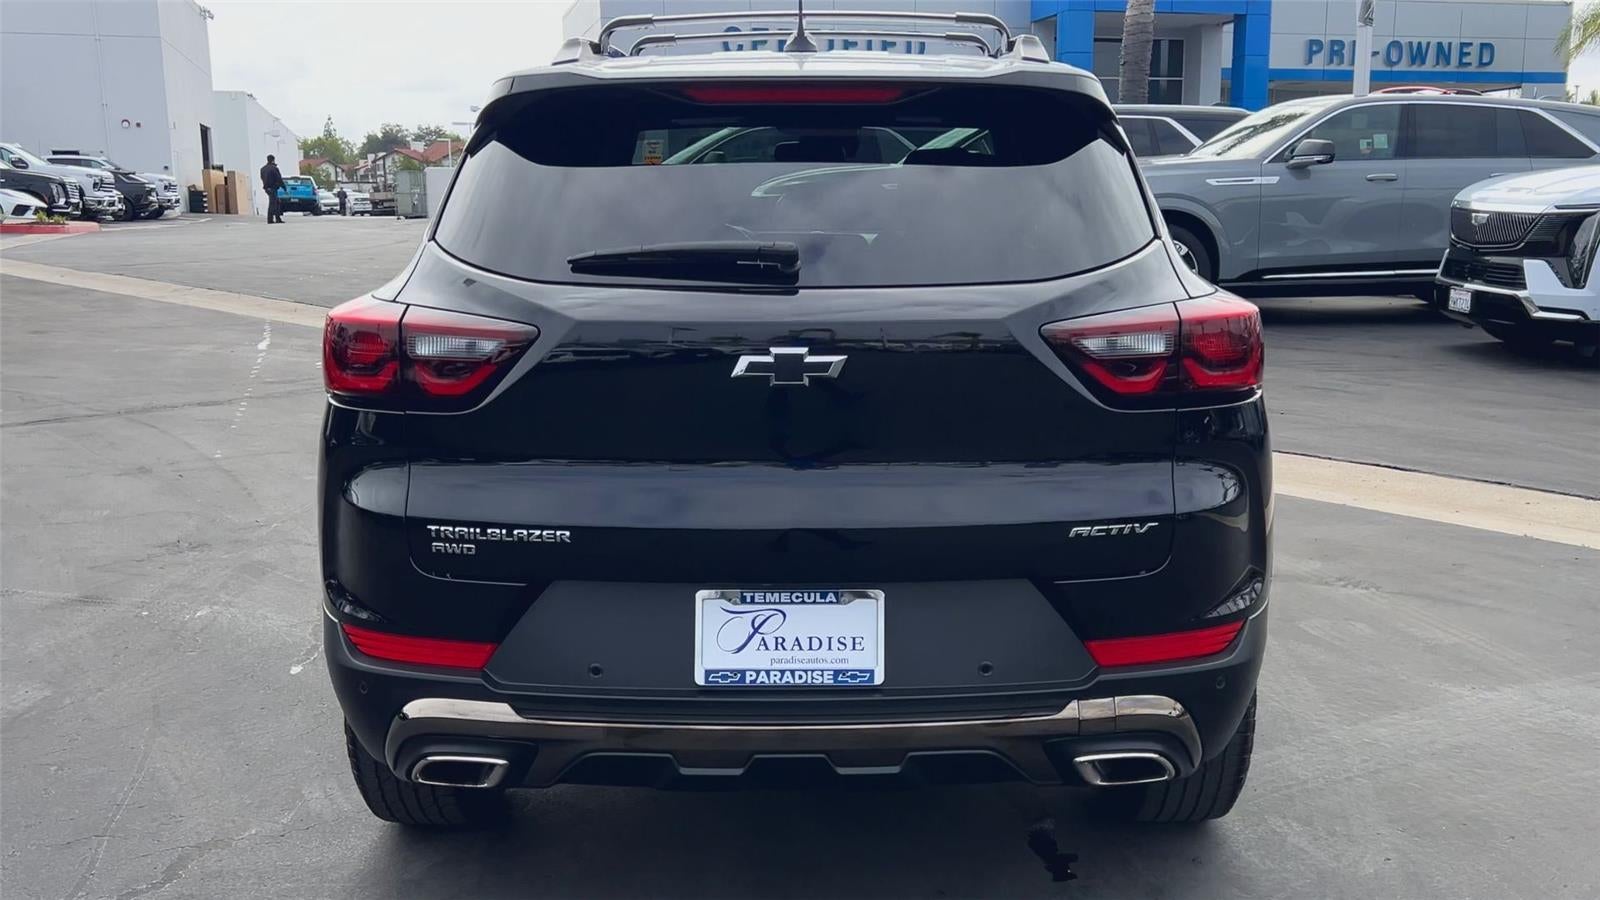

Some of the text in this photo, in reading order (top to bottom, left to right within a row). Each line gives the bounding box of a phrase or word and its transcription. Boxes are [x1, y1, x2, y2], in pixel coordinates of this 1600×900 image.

[722, 26, 926, 54] CEIFIED
[426, 525, 571, 543] TRAILBLAZER
[1068, 522, 1159, 538] ACTIV
[432, 542, 476, 555] AWD
[742, 592, 838, 603] TEMECULA
[769, 655, 849, 666] paradiseautos.com
[745, 670, 834, 684] PARADISE
